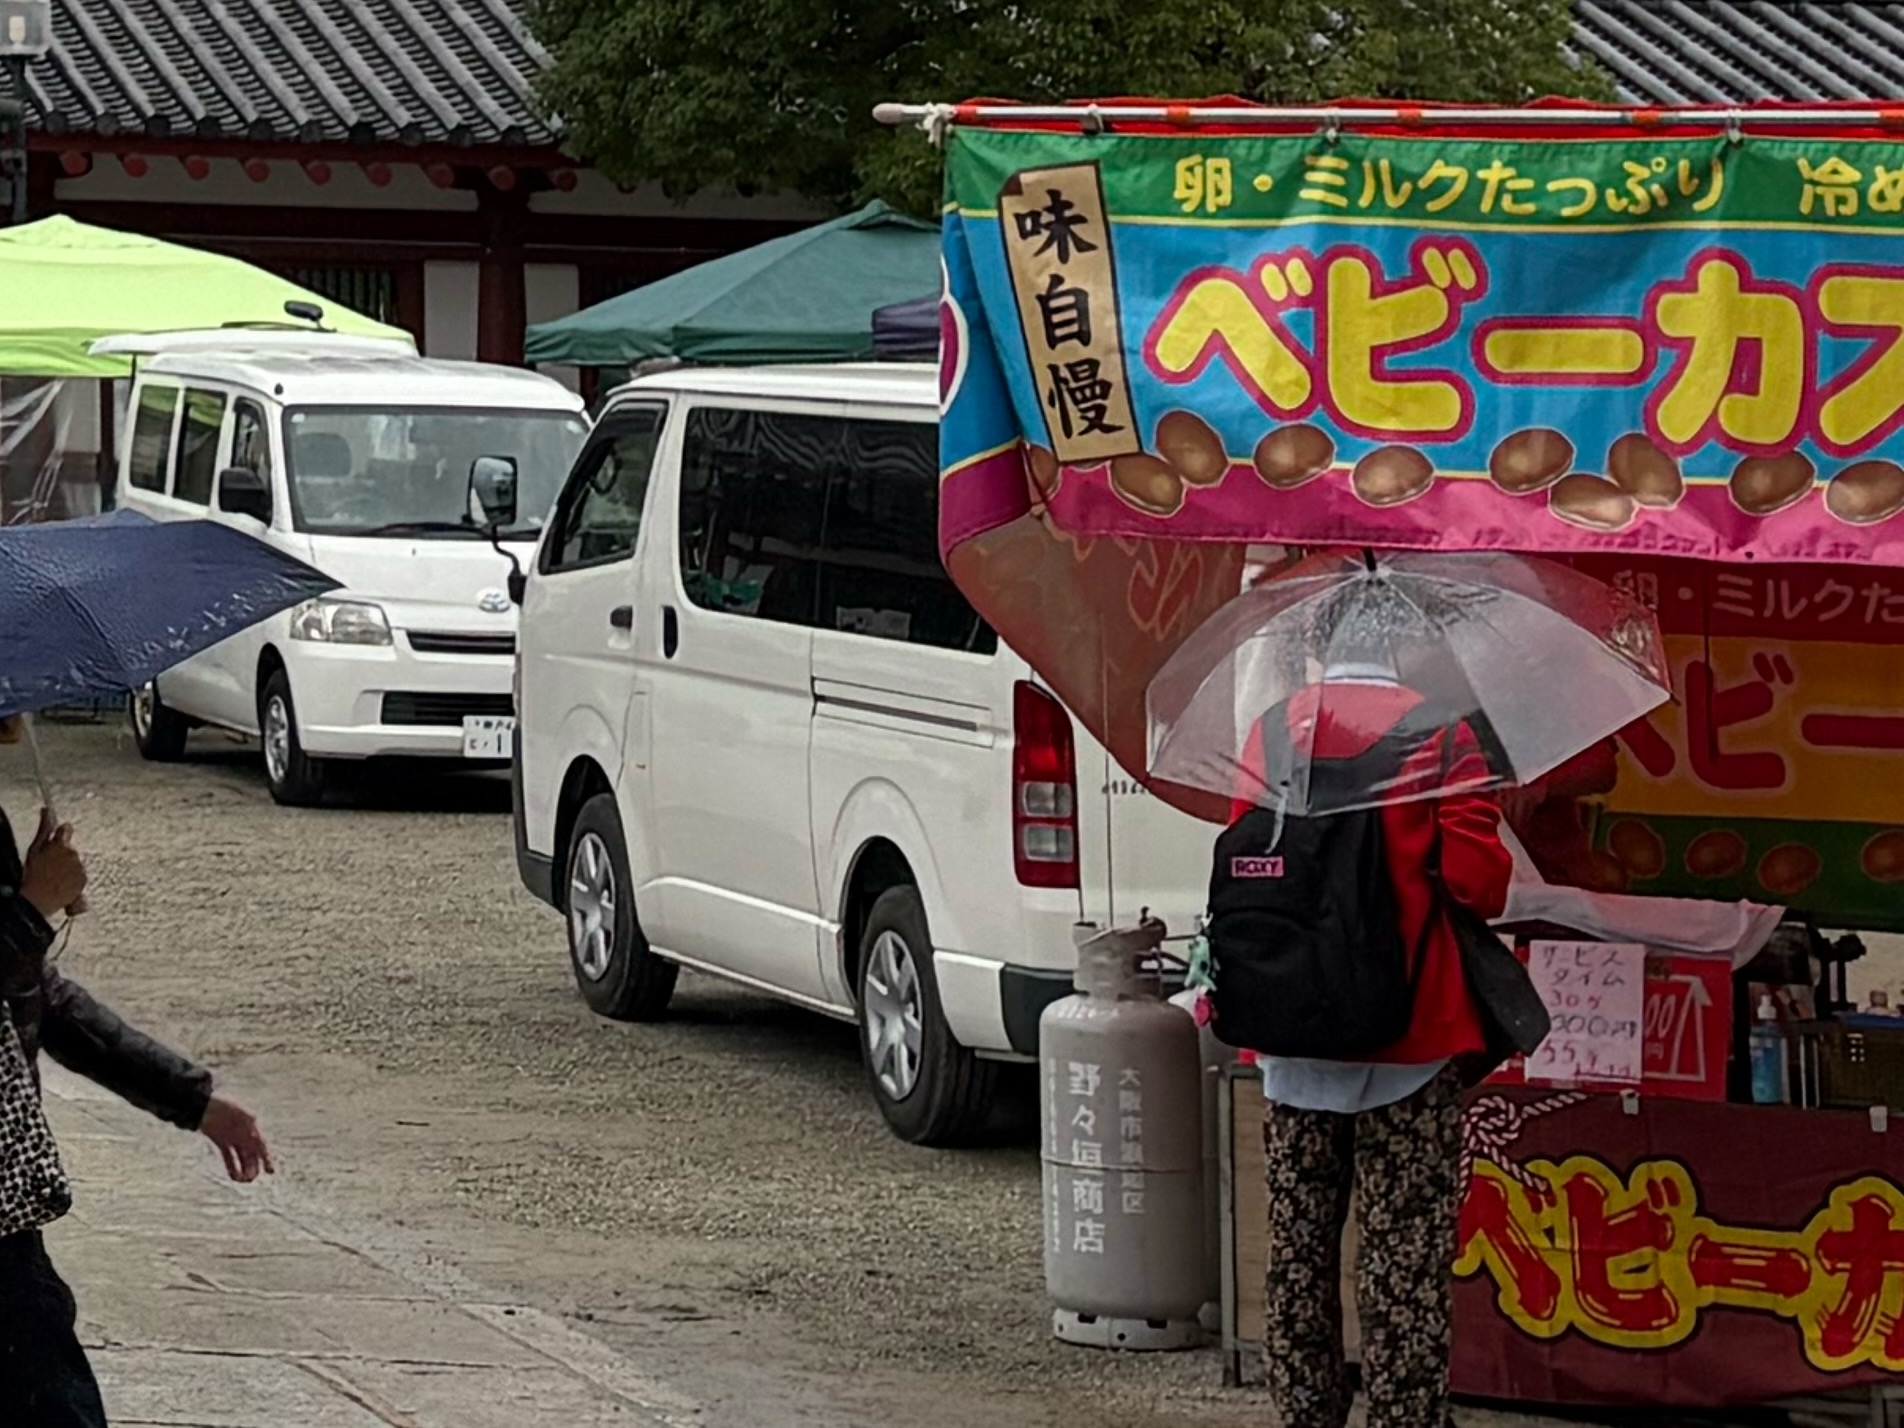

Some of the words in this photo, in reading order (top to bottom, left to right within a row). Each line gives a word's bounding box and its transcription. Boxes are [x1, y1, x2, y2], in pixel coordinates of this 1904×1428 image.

[1173, 154, 1725, 216] 卵・ミルクたっぷり
[1012, 188, 1126, 440] 味自慢
[1234, 858, 1282, 875] ROXY
